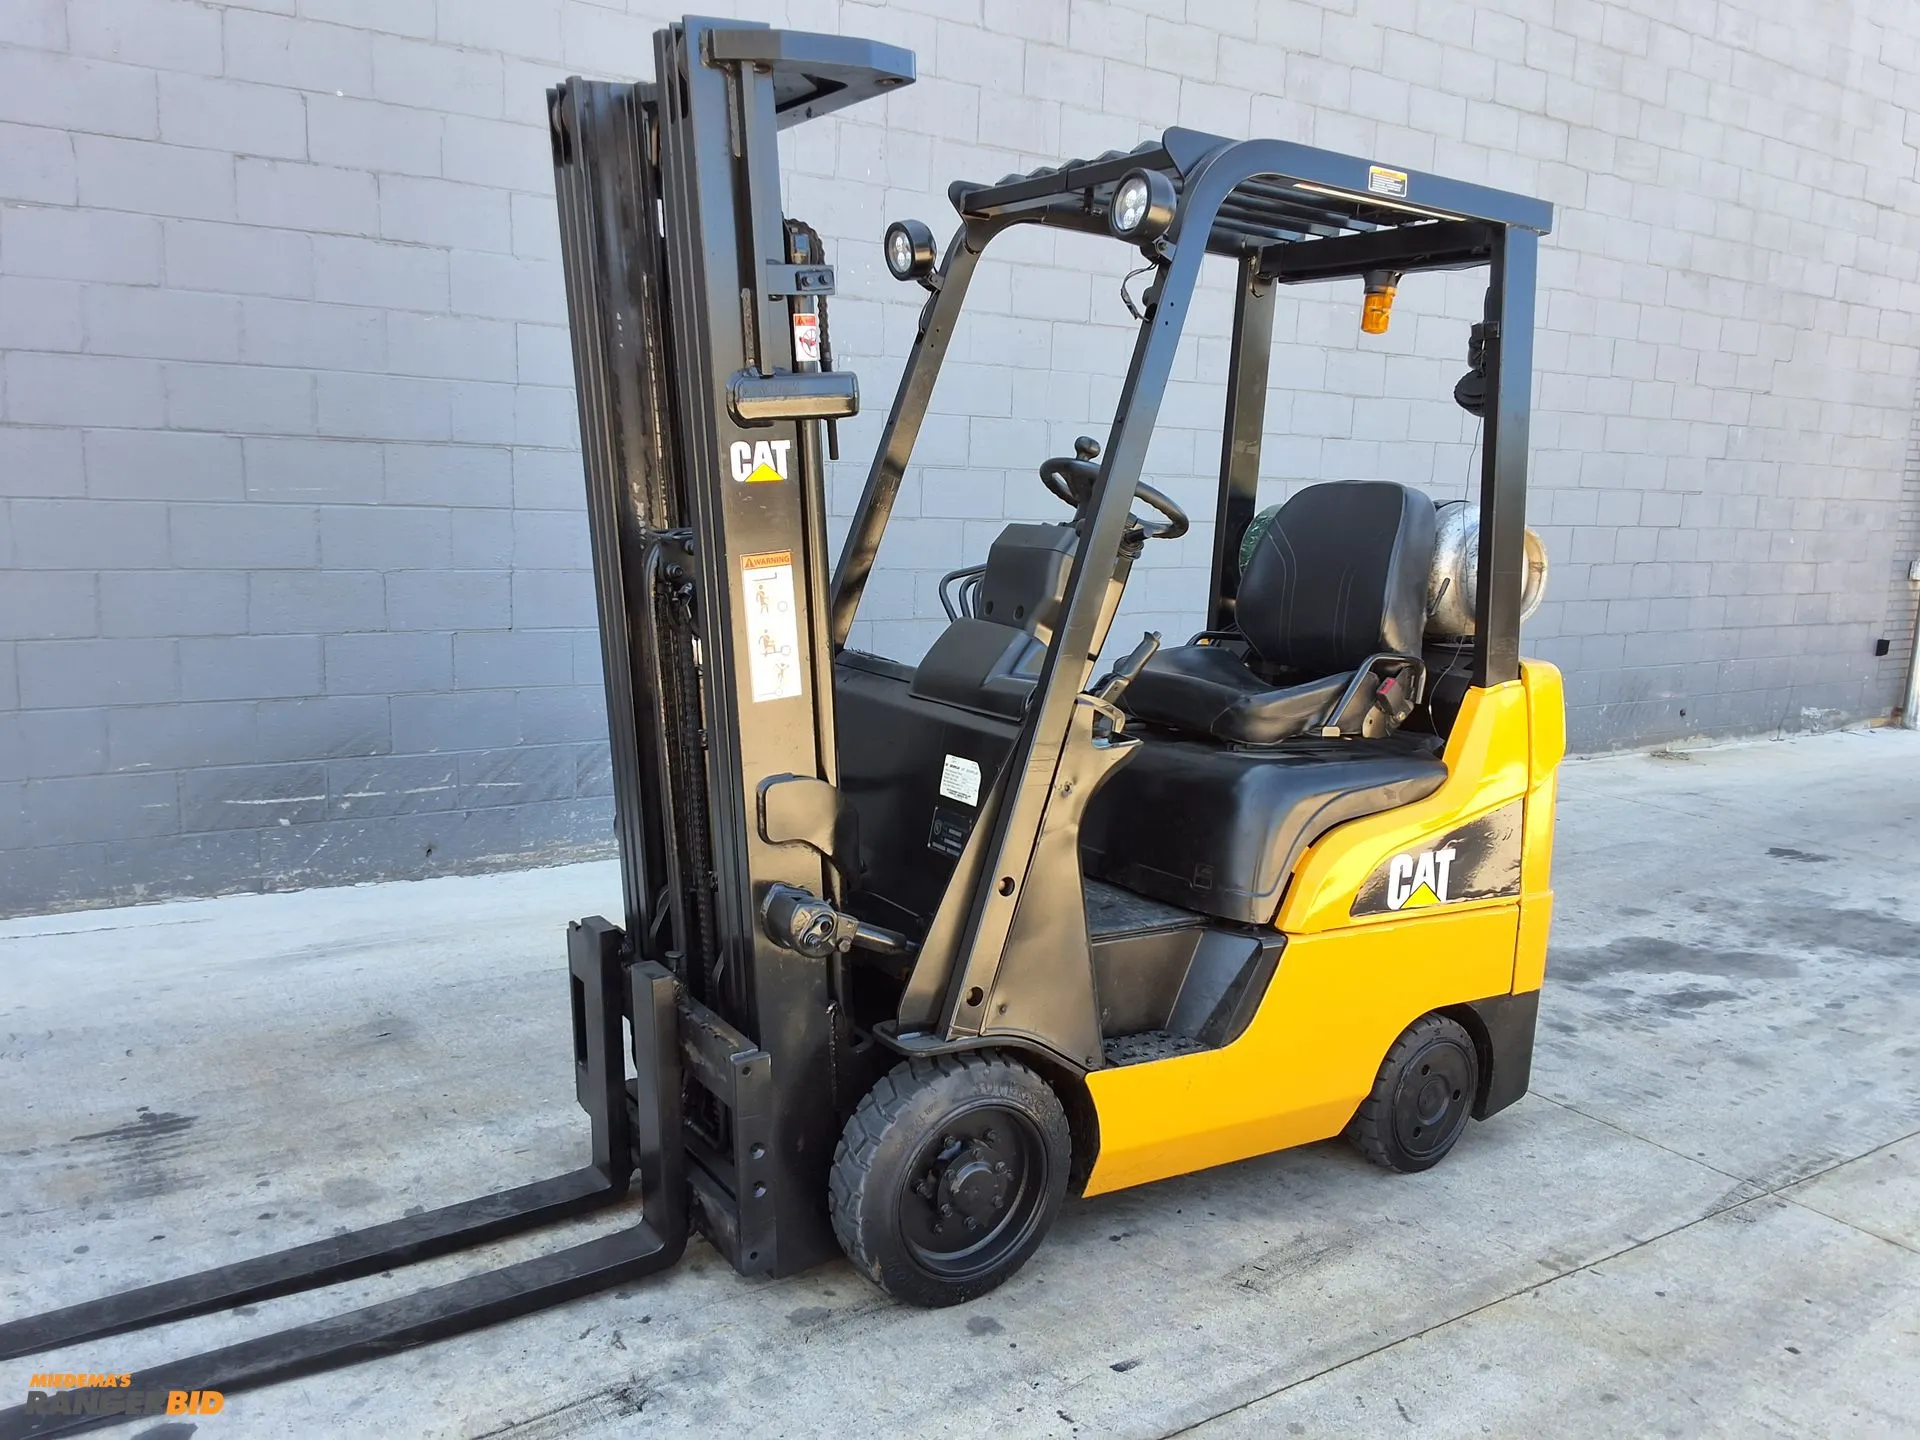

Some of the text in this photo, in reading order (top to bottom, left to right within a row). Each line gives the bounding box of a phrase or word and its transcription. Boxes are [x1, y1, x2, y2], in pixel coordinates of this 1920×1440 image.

[730, 440, 791, 482] CAT
[754, 556, 790, 565] WARNING
[1386, 848, 1457, 910] CAT
